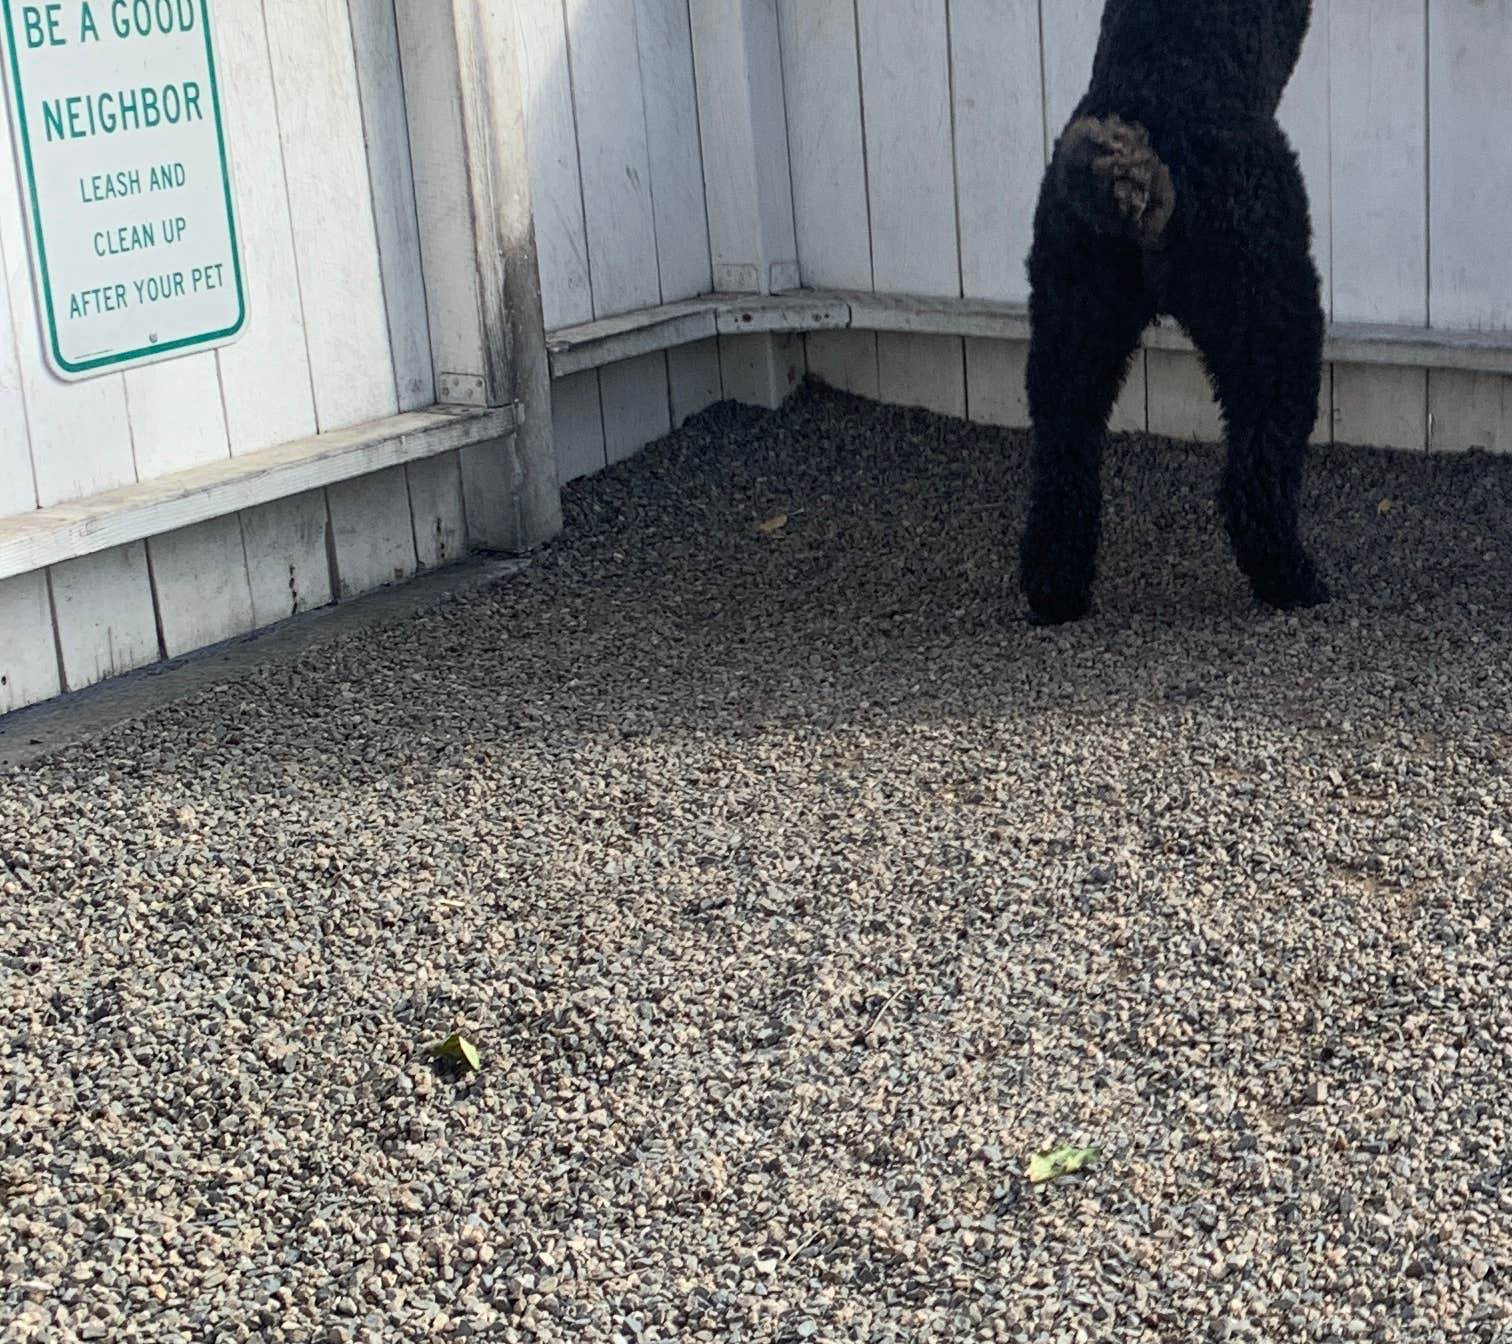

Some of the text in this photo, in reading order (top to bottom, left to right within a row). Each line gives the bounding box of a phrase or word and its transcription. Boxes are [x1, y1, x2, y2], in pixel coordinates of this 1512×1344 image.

[23, 4, 66, 48] BE
[80, 1, 99, 43] A
[42, 81, 203, 142] NEIGHBOR
[80, 163, 185, 203] LEASH AND
[94, 217, 186, 257] CLEAN UP
[70, 263, 223, 319] AFTER YOUR PET
